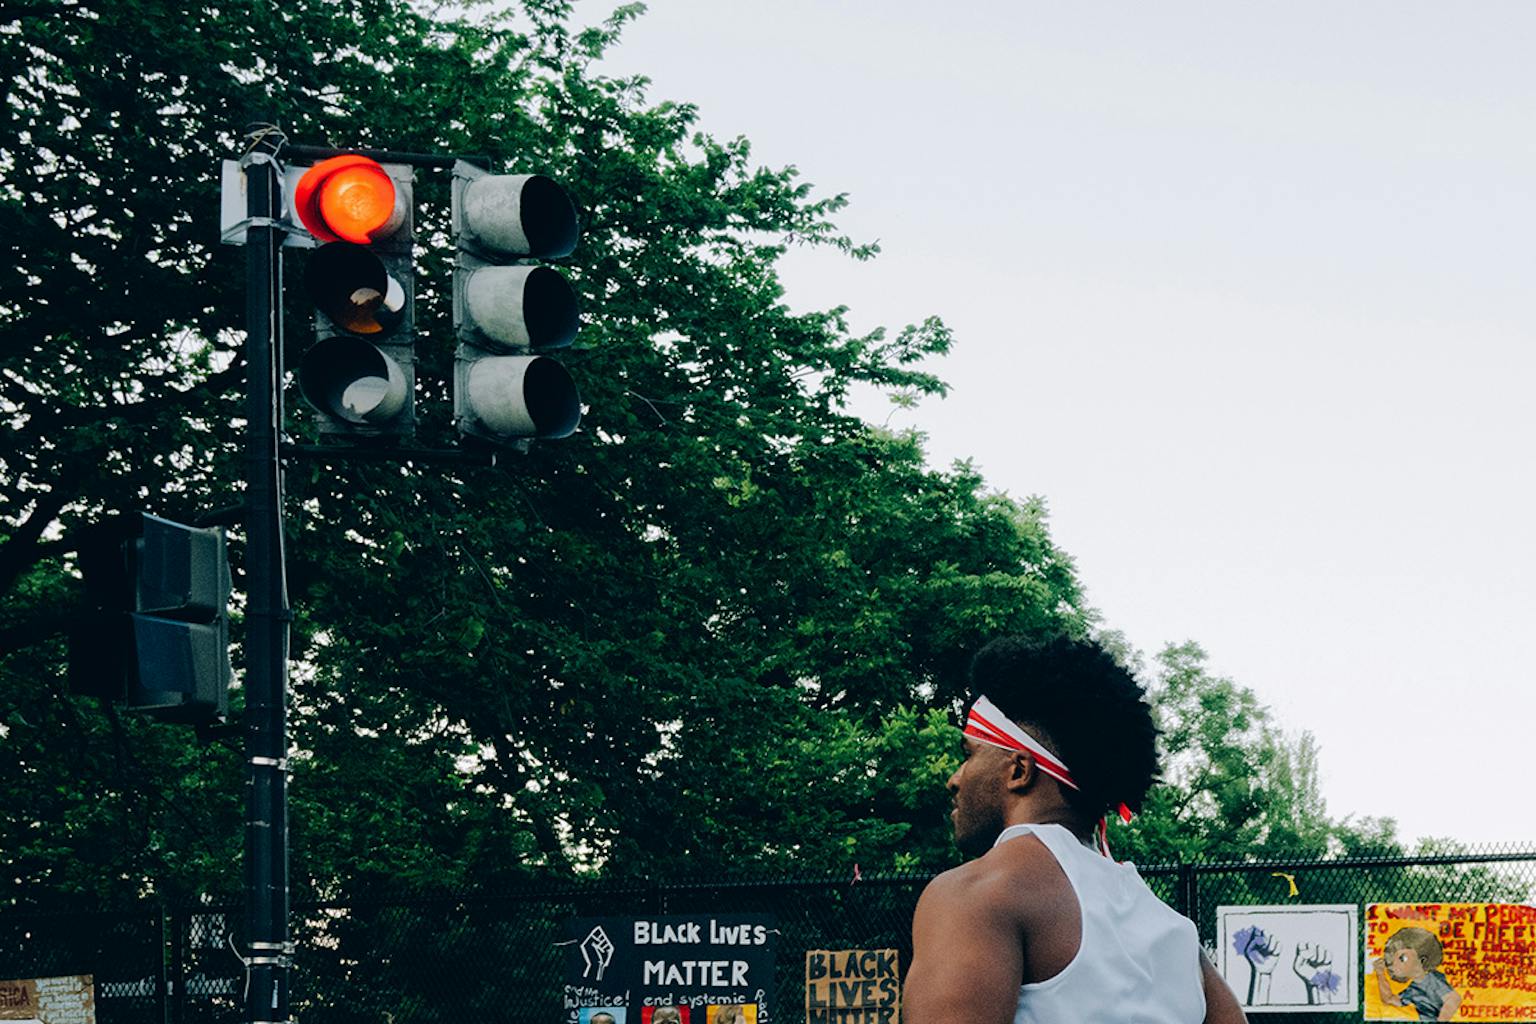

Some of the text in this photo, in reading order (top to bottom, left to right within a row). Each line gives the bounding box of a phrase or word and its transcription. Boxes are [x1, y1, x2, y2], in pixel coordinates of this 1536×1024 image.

[1368, 905, 1378, 920] I
[1385, 905, 1441, 921] WANT
[1449, 907, 1477, 922] MY
[634, 919, 767, 946] BLACK LIVES
[1368, 922, 1388, 934] TO
[1440, 921, 1465, 938] BE
[643, 960, 749, 987] MATTER
[809, 952, 897, 979] BLACK
[643, 992, 673, 1006] end
[679, 992, 746, 1009] systemic
[809, 978, 897, 1008] LIVES
[1463, 990, 1475, 1001] A
